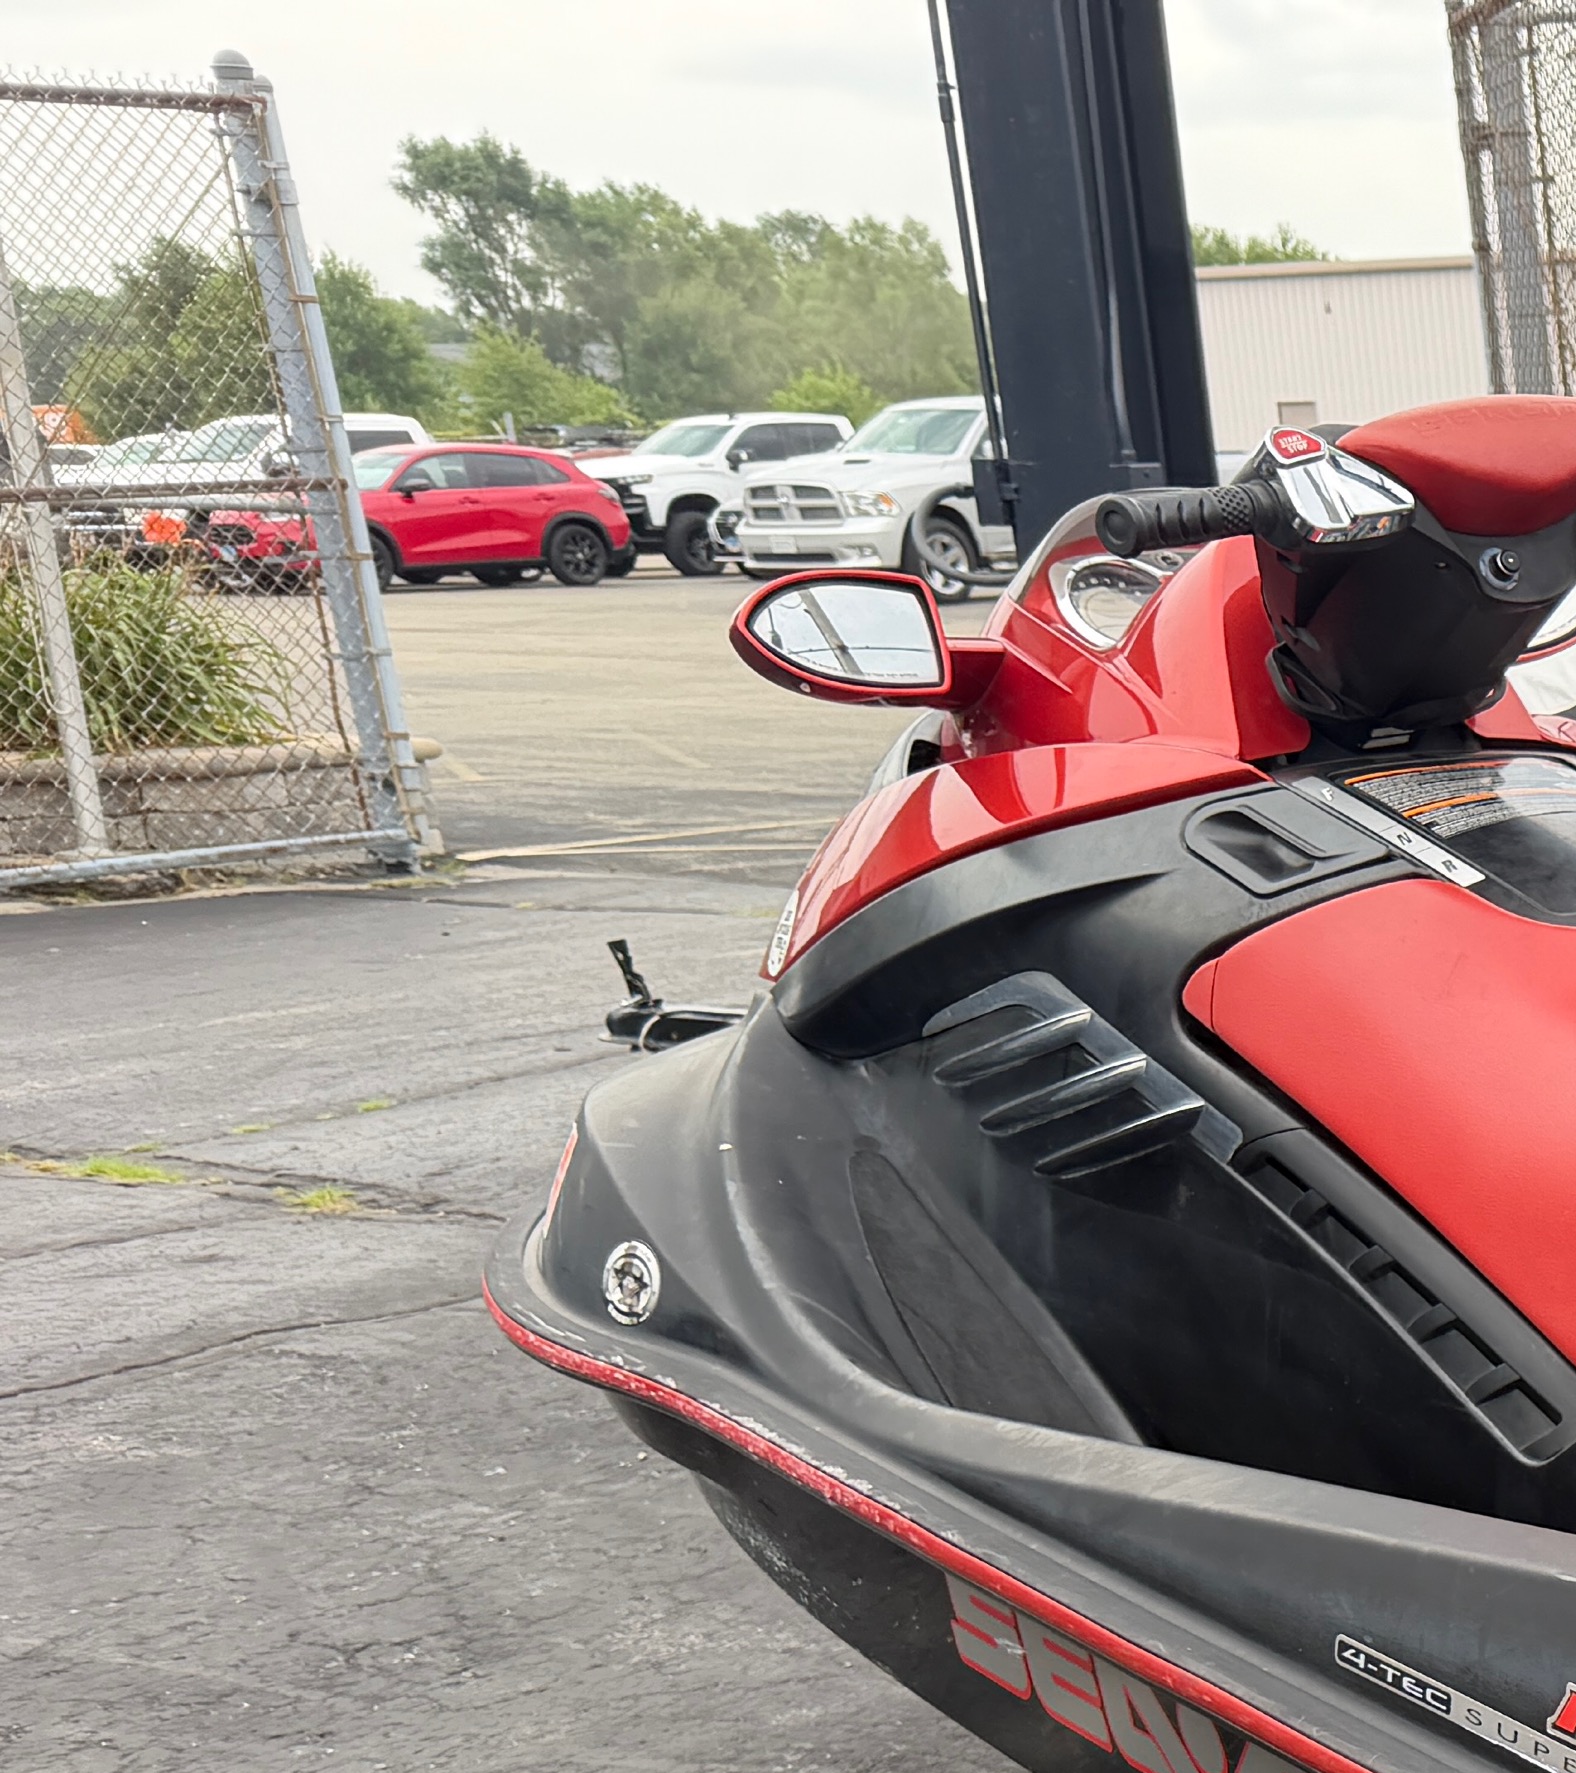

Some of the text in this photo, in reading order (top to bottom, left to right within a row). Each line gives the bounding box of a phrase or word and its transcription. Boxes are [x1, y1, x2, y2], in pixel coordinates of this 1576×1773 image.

[1321, 787, 1336, 802] F
[1396, 831, 1414, 847] N
[1440, 858, 1458, 873] R
[1342, 1643, 1449, 1711] 4-TEC
